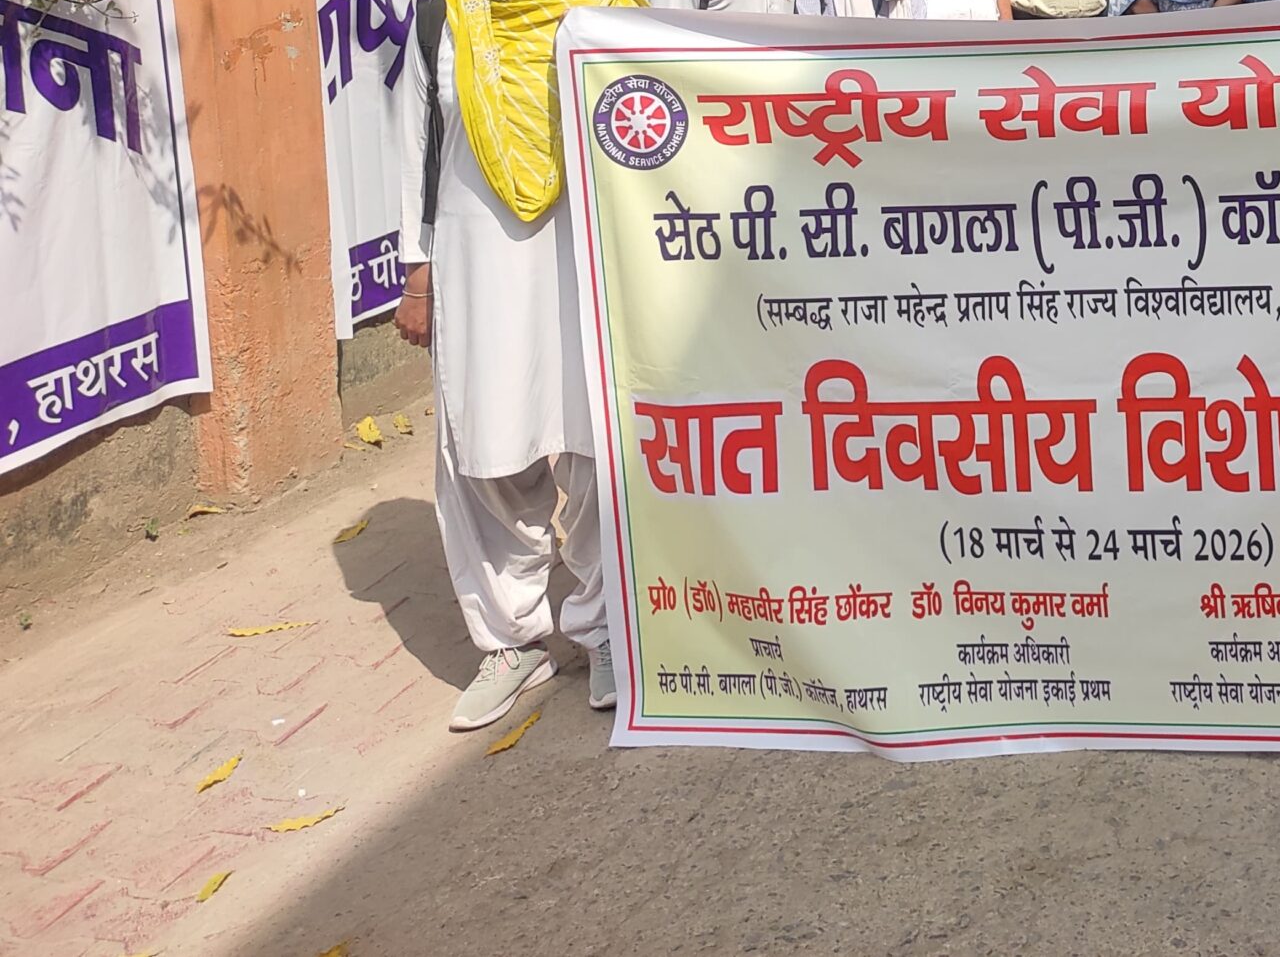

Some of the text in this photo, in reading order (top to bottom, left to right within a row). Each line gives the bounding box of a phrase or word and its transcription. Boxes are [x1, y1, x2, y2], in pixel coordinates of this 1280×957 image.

[598, 76, 682, 114] राष्ट्रीय सेवा योजना
[698, 68, 956, 169] राष्ट्रीय
[978, 65, 1155, 141] सेवा
[596, 120, 685, 166] NATIONAL SERVICE SCHEME
[654, 191, 721, 261] सेठ
[730, 184, 787, 261] पी.
[799, 182, 869, 258] सी.
[881, 203, 1019, 254] बागला
[756, 293, 833, 331] (सम्बद्ध
[838, 294, 887, 325] राजा
[895, 282, 946, 328] महेन्द्र
[954, 290, 1010, 322] प्रताप
[1016, 279, 1061, 322] सिंह
[1065, 288, 1117, 319] राज्य
[27, 331, 159, 424] हाथरस
[634, 401, 783, 496] सात
[802, 356, 1097, 495] दिवसीय
[940, 516, 1274, 566] (18 मार्च से 24 मार्च 2026)
[726, 587, 784, 624] महावीर
[788, 586, 829, 625] सिंह
[835, 583, 892, 622] छोंकर
[953, 579, 1005, 616] विनय
[1010, 592, 1066, 631] कुमार
[1070, 582, 1108, 618] वर्मा
[1200, 583, 1226, 618] श्री
[750, 635, 784, 662] प्राचार्य
[957, 634, 1070, 665] कार्यक्रम अधिकारी
[1208, 632, 1262, 663] कार्यक्रम
[658, 664, 677, 694] सेठ
[718, 674, 756, 696] बागला
[803, 679, 844, 713] कॉलेज,
[844, 686, 888, 714] हाथरस
[918, 671, 1111, 713] राष्ट्रीय सेवा योजना इकाई प्रथम
[1169, 674, 1213, 711] राष्ट्रीय
[1216, 674, 1244, 704] सेवा
